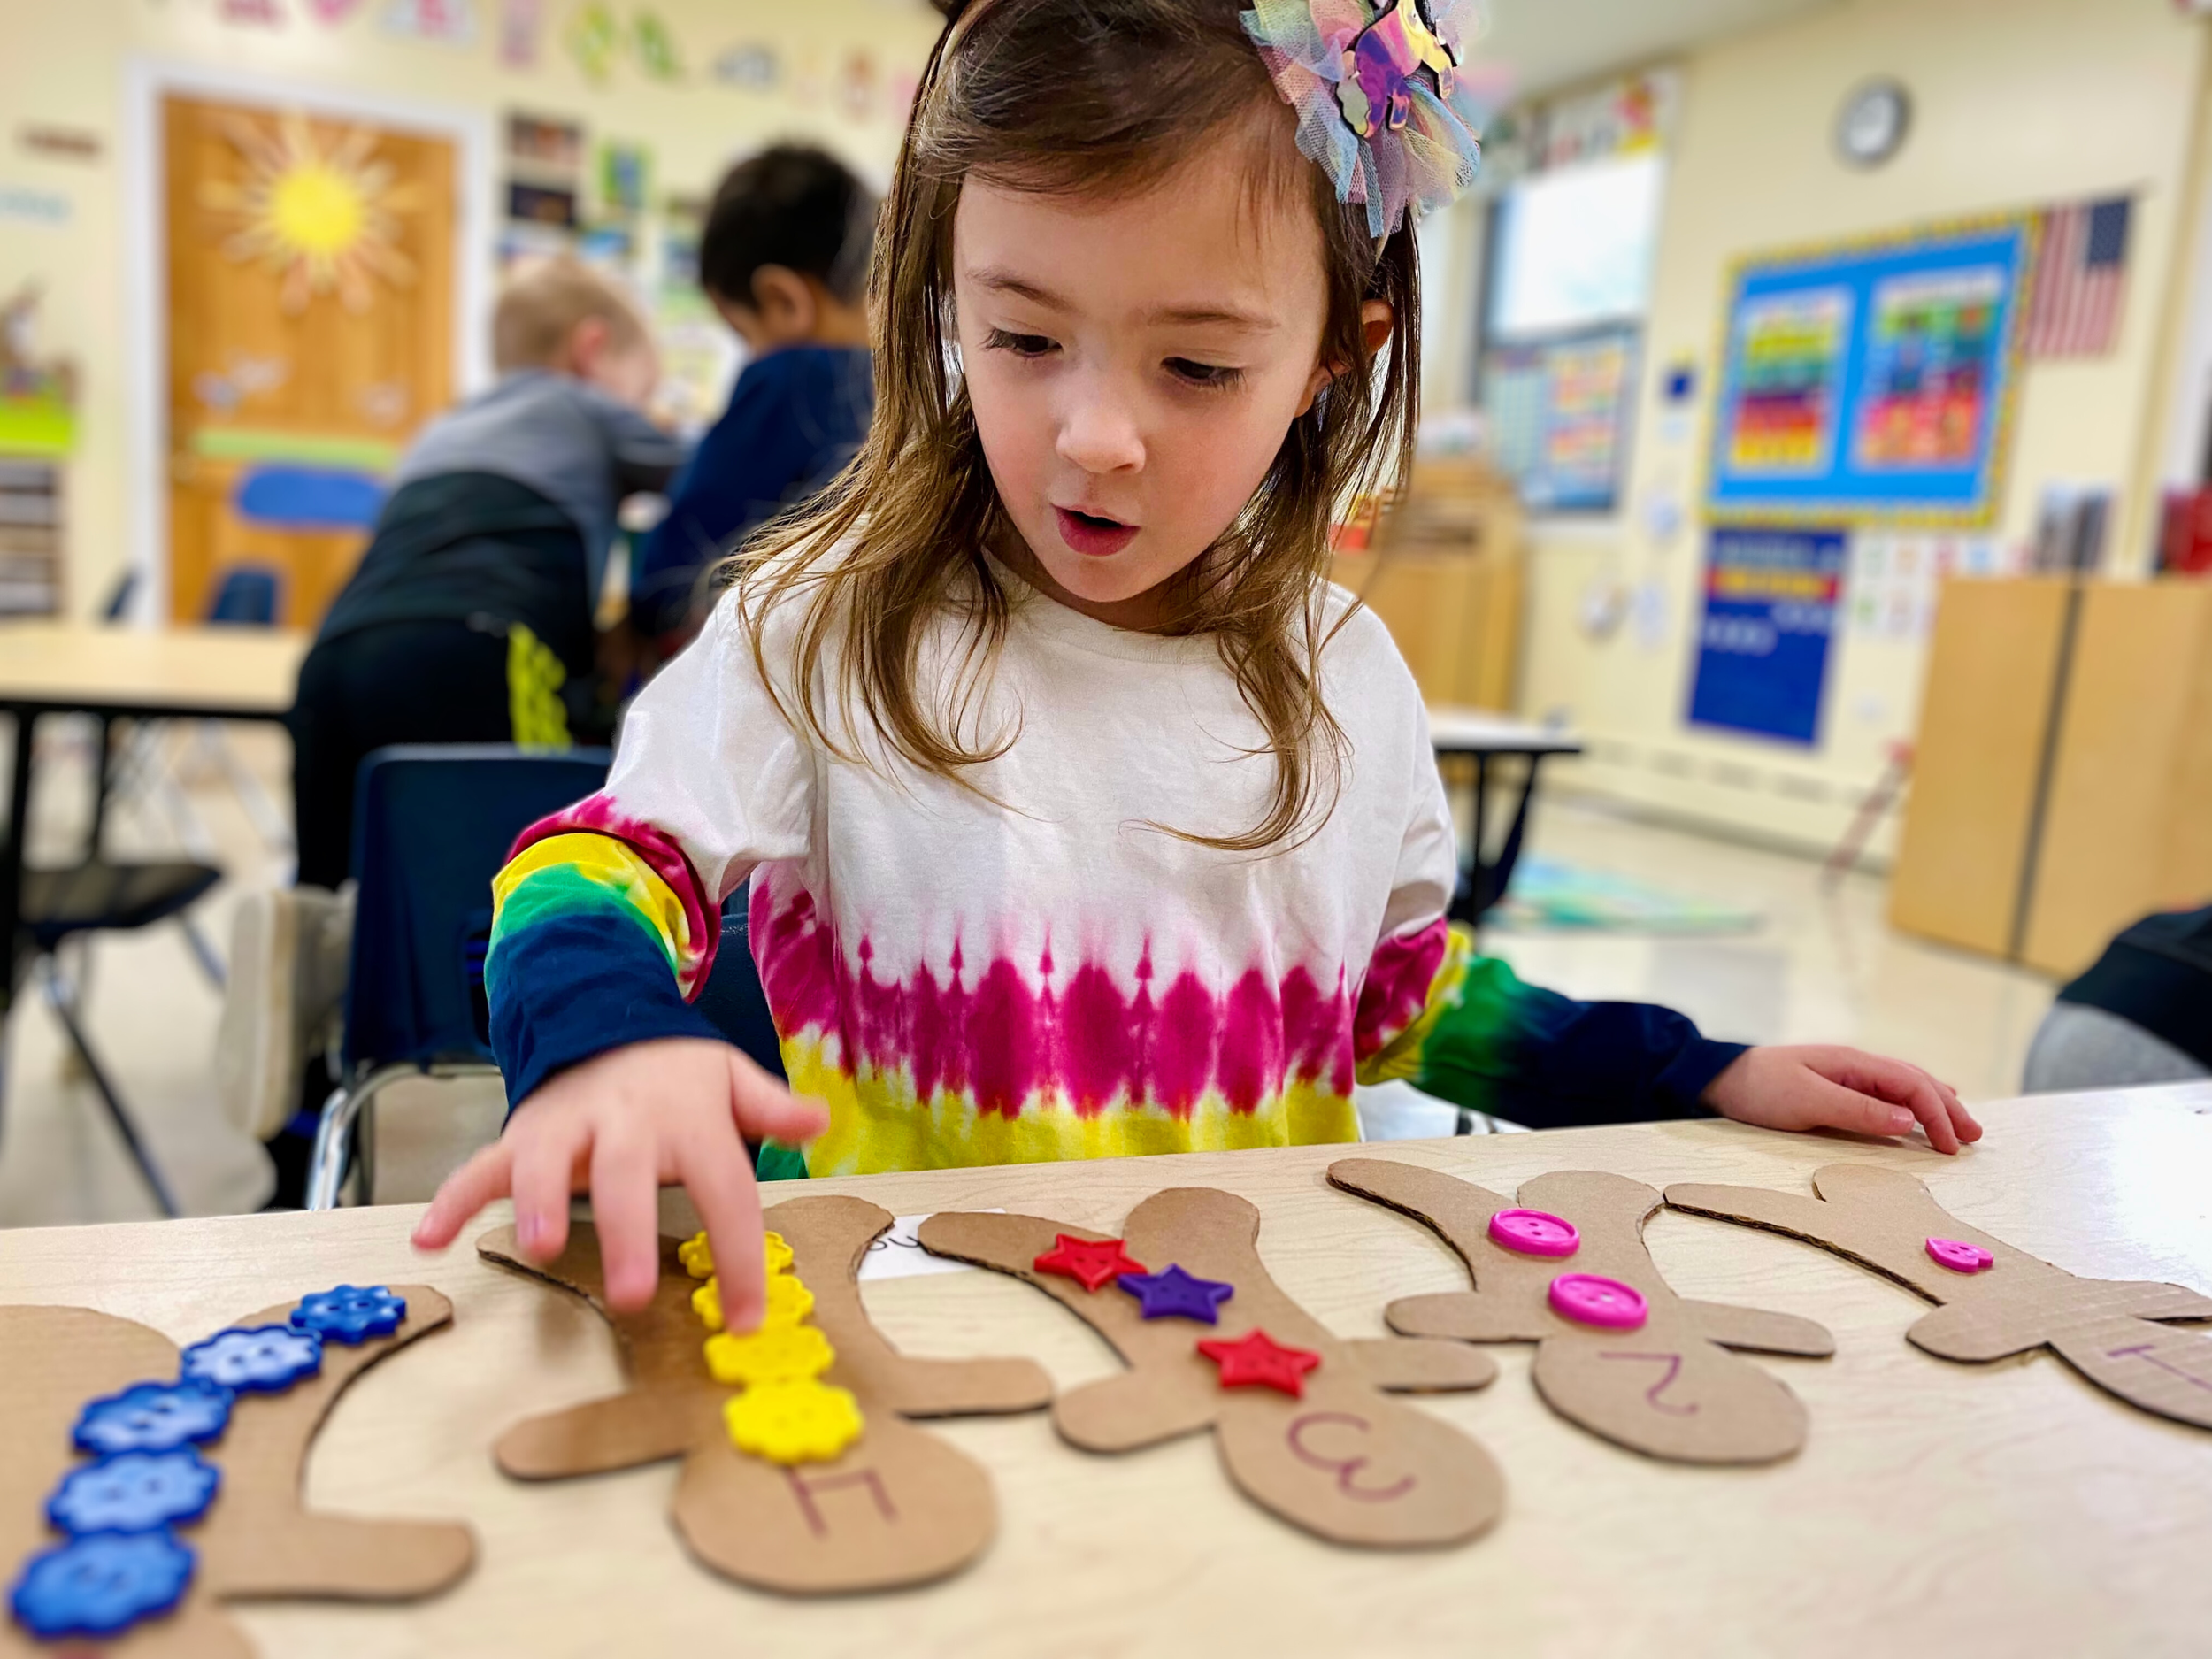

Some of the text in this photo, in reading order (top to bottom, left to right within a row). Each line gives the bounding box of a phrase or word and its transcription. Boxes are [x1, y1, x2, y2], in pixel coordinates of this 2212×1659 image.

[1597, 1350, 1700, 1417] 2
[1286, 1412, 1416, 1502] 3
[782, 1464, 899, 1540] 4
